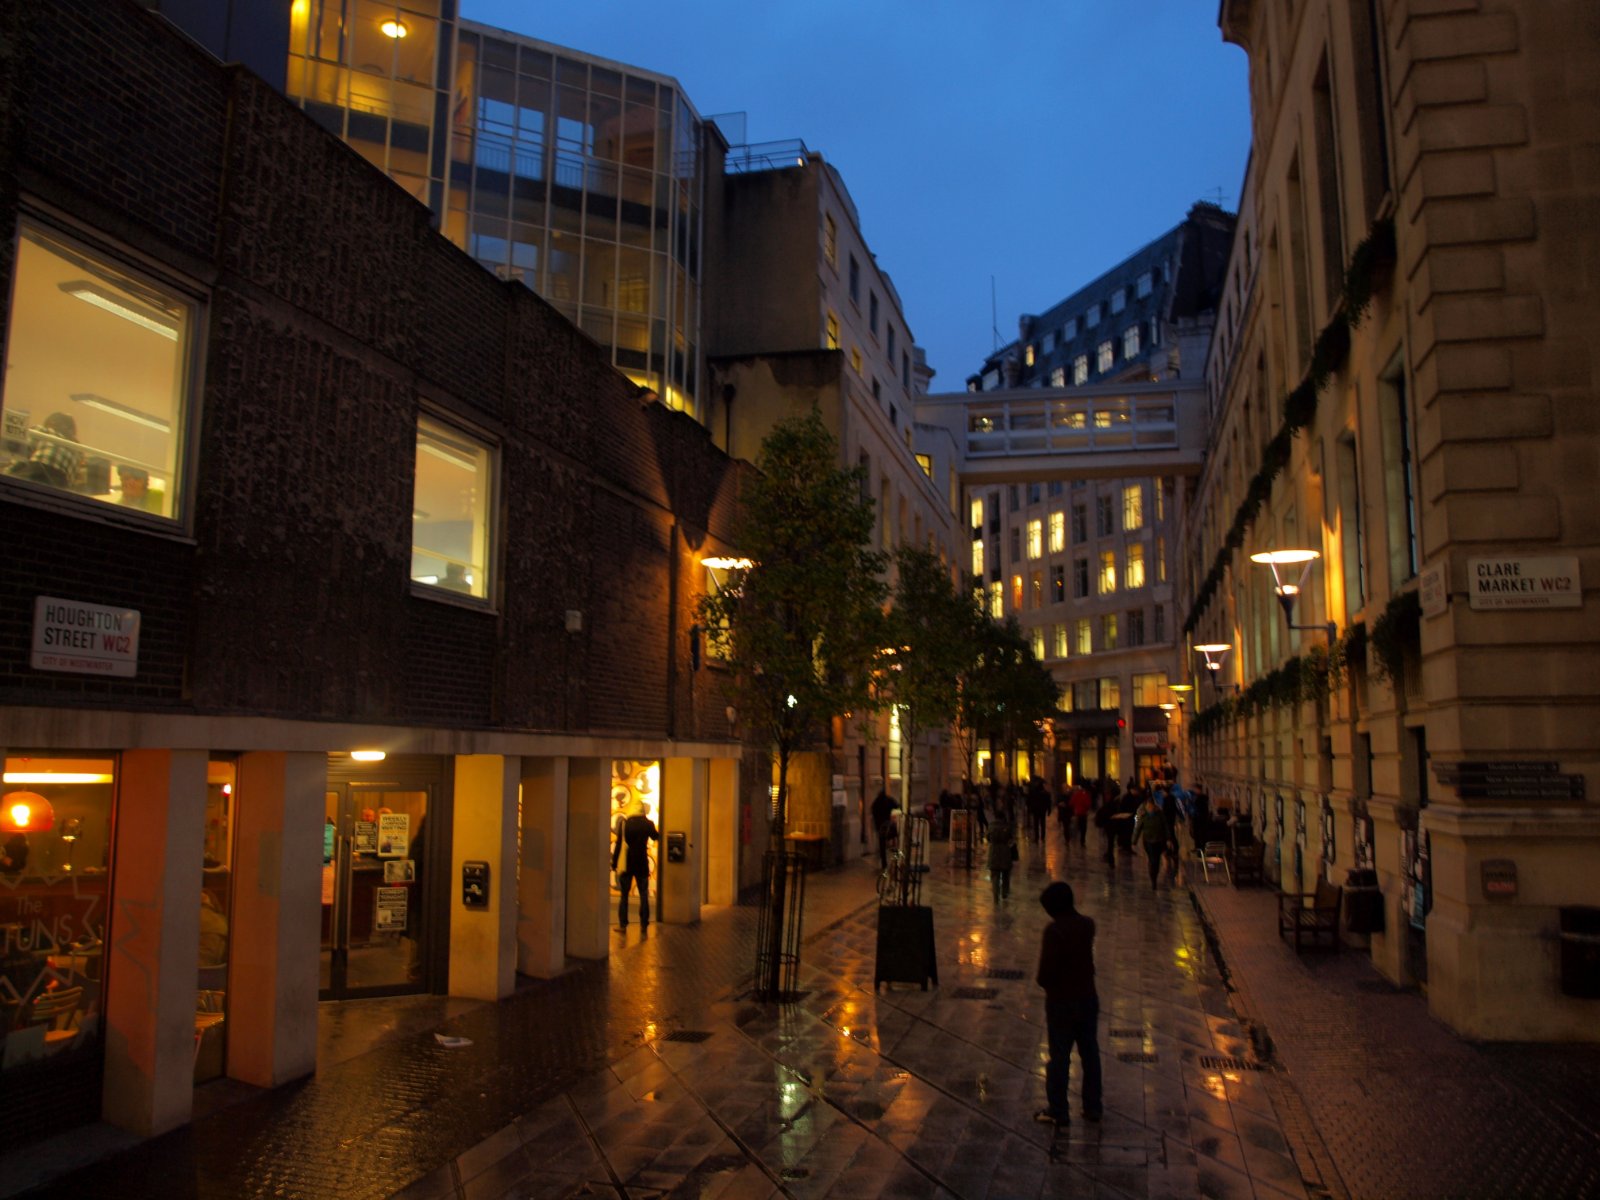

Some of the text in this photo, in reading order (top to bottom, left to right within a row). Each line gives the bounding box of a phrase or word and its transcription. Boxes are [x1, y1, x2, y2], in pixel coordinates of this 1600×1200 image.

[1477, 563, 1520, 577] CLARE
[1478, 576, 1571, 593] MARKET WC2
[46, 604, 121, 632] HOUGHTON
[44, 626, 131, 655] STREET WC2
[16, 897, 43, 915] The
[0, 914, 74, 954] TUNS
